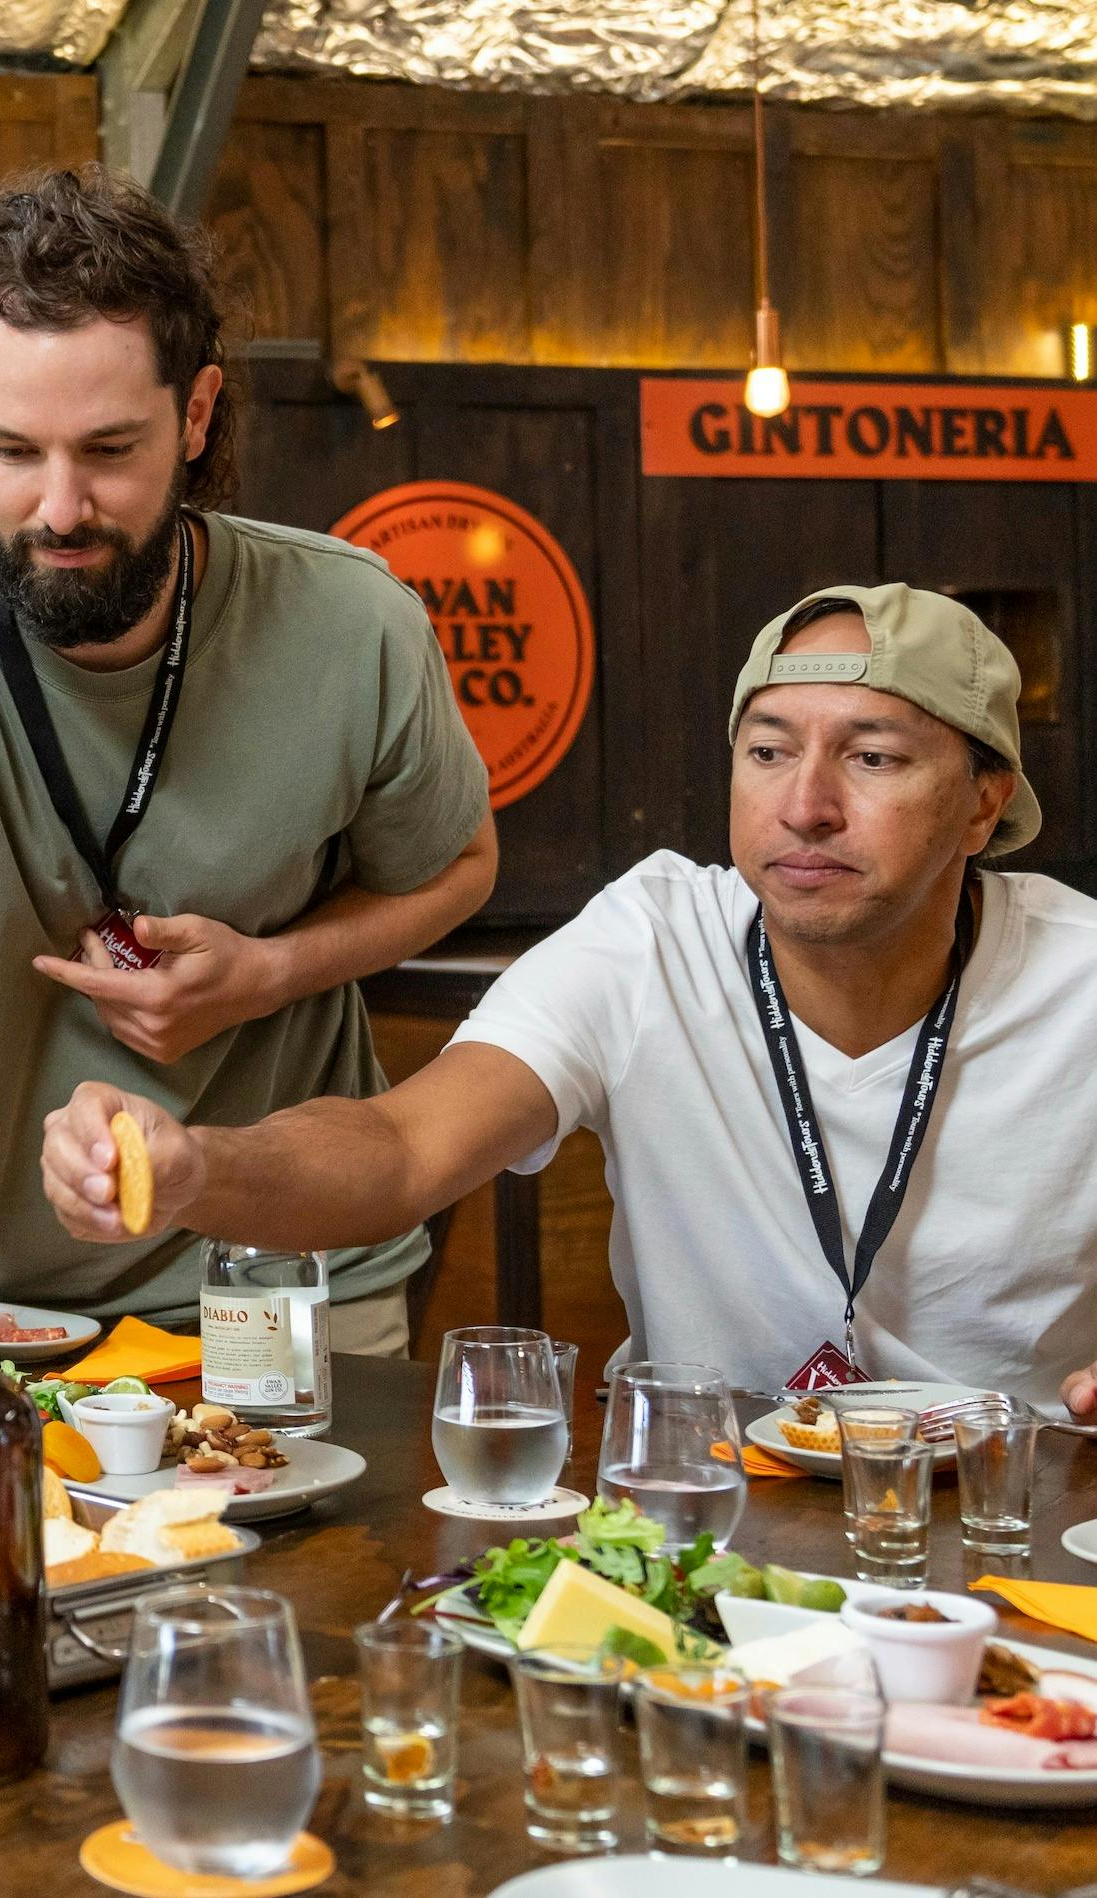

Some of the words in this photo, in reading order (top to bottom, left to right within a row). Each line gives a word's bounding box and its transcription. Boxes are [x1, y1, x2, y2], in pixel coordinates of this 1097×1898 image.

[690, 403, 1075, 459] GINTONERIA
[405, 577, 516, 617] WAN
[437, 624, 533, 662] LEY
[460, 669, 535, 707] CO.
[100, 928, 142, 969] Hidden
[787, 1075, 799, 1094] with
[903, 1135, 913, 1152] with
[888, 1151, 908, 1192] personality
[203, 1305, 248, 1323] DIABLO
